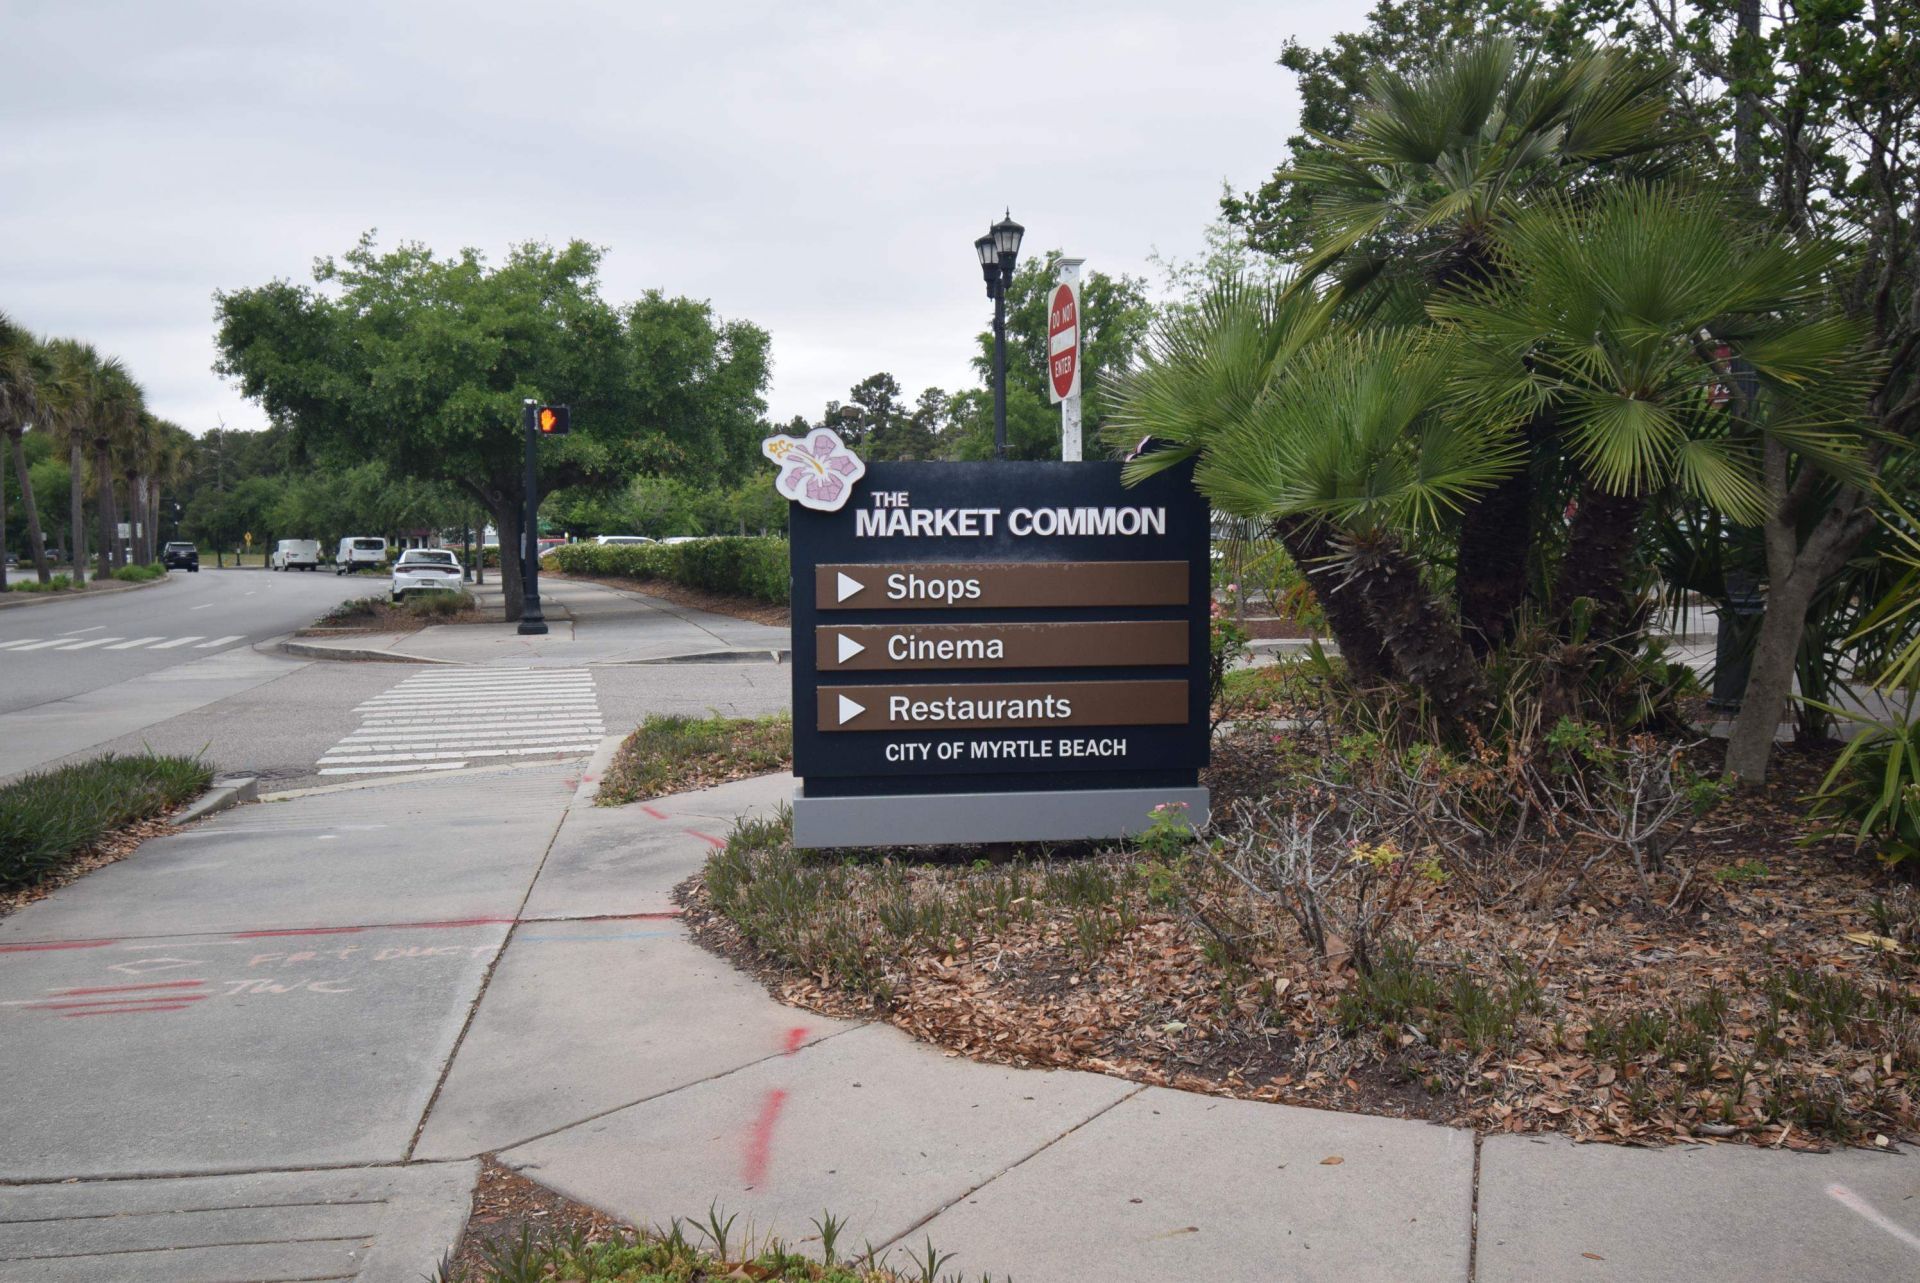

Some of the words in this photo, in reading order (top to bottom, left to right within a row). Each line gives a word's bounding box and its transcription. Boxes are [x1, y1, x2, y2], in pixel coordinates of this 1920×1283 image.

[1053, 310, 1060, 329] DO
[1062, 302, 1073, 323] NOT
[1055, 355, 1072, 378] ENTER
[871, 491, 909, 507] THE
[856, 508, 1001, 537] MARKET
[1008, 507, 1166, 536] COMMON
[887, 573, 981, 604] Shops
[888, 634, 1004, 661] Cinema
[889, 694, 1072, 721] Restaurants
[885, 743, 931, 762] CITY
[937, 742, 964, 760] OF
[970, 740, 1053, 759] MYRTLE
[1059, 738, 1127, 757] BEACH
